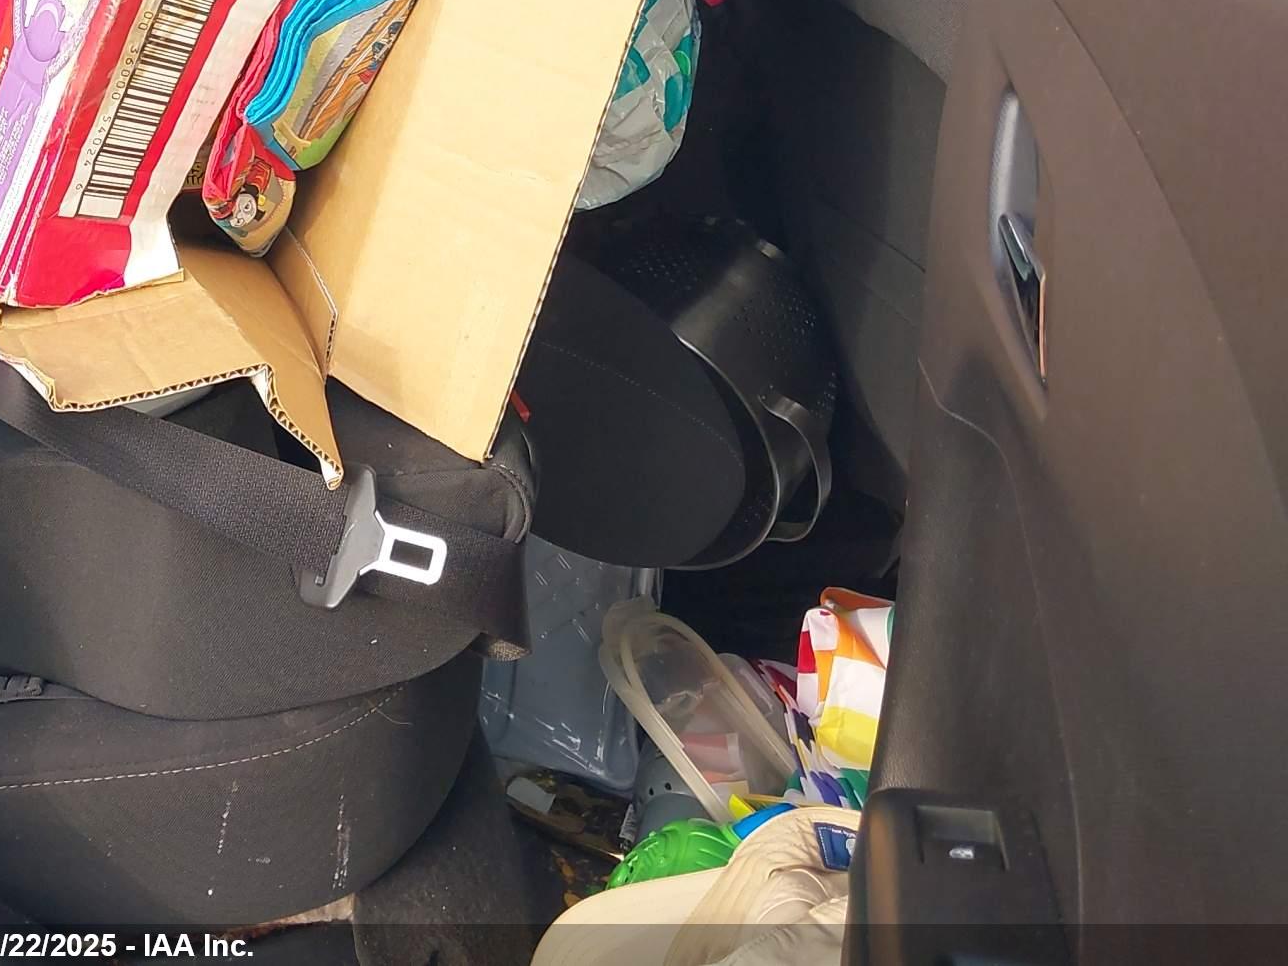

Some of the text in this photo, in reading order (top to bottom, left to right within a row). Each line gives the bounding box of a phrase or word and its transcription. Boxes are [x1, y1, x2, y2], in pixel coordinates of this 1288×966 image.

[138, 10, 154, 32] 00
[111, 45, 139, 101] 36000
[83, 114, 112, 168] 54024
